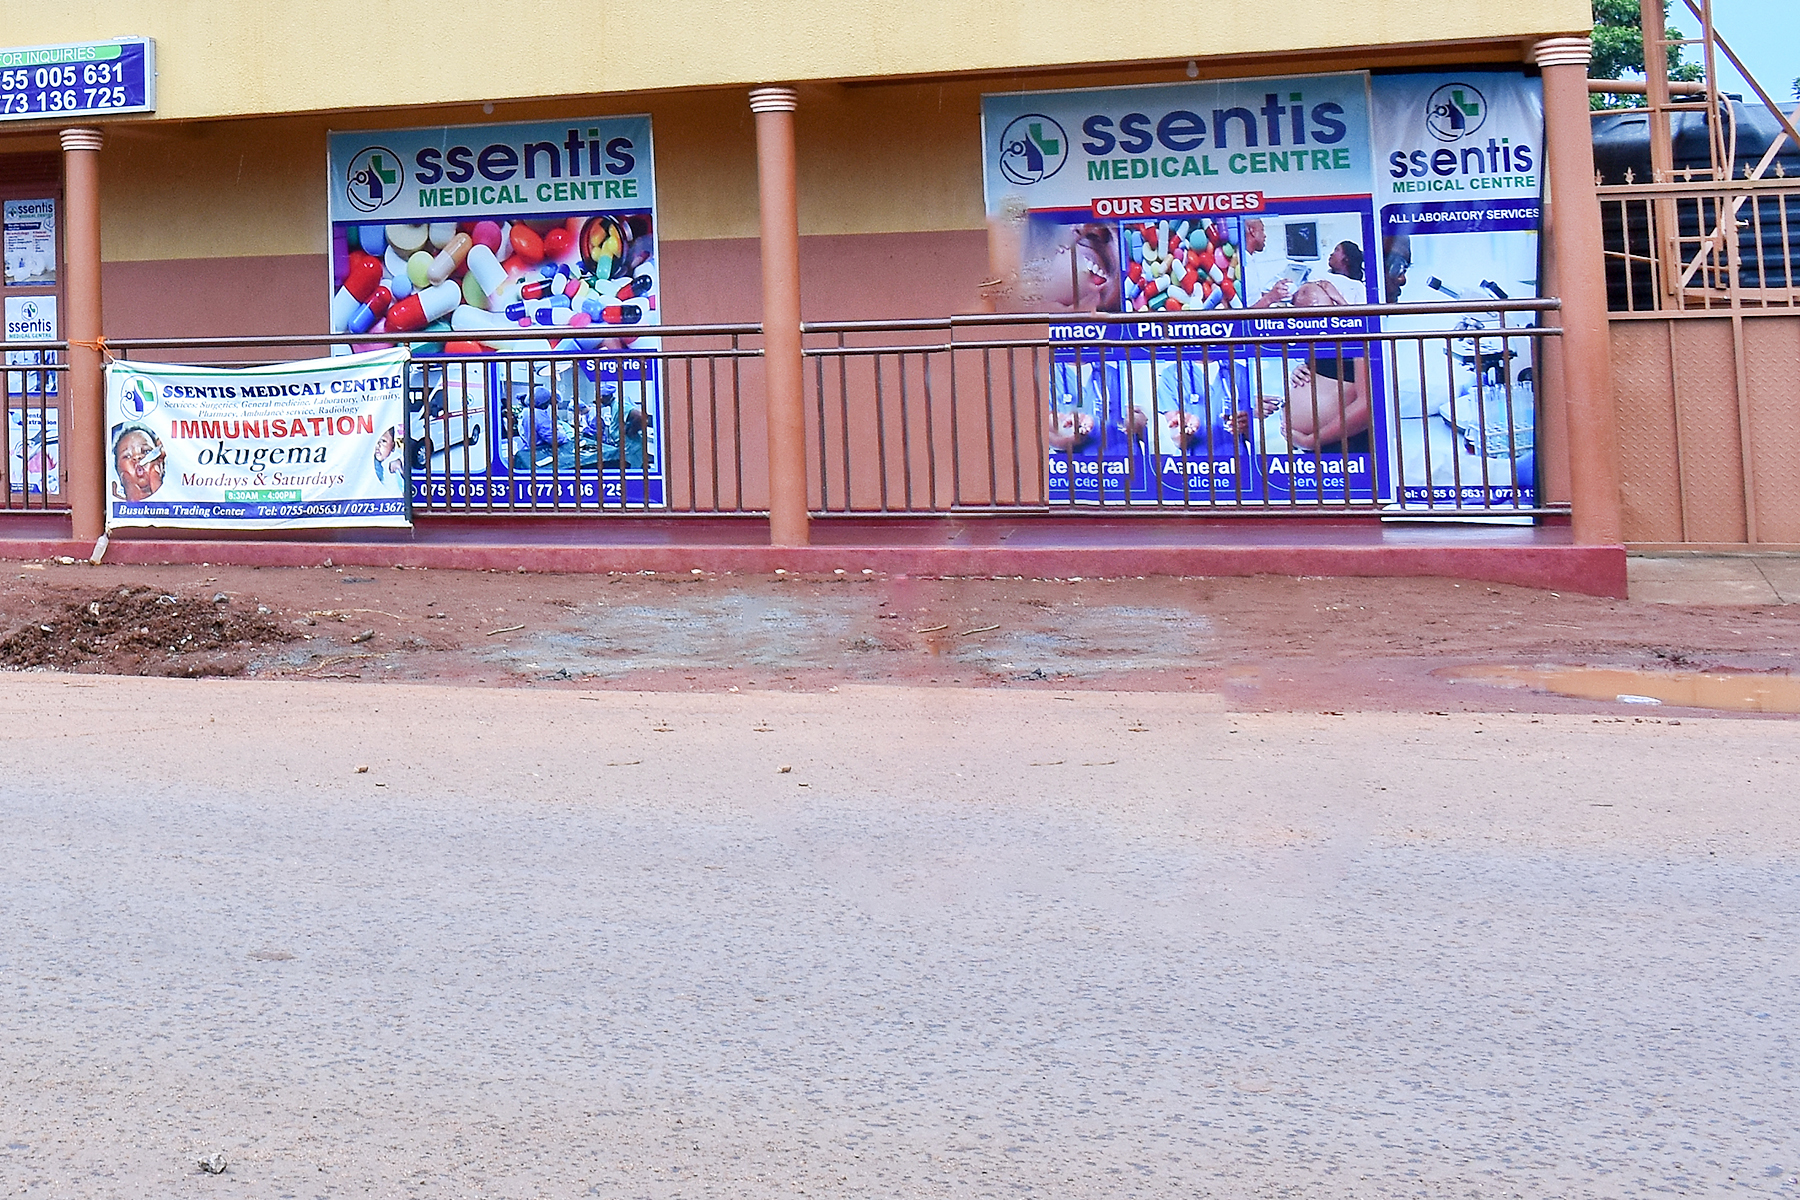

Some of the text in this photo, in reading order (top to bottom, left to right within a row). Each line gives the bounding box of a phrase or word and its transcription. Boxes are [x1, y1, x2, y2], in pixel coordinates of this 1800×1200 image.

[27, 47, 96, 64] INQUIRIES
[35, 65, 76, 88] 005
[83, 62, 123, 85] 631
[36, 89, 77, 111] 136
[84, 87, 126, 108] 725
[1082, 92, 1347, 156] ssentis
[415, 128, 635, 184] ssentis
[1087, 148, 1351, 181] MEDICAL CENTRE
[1389, 137, 1533, 178] ssentis
[419, 179, 638, 208] MEDICAL CENTRE
[1392, 175, 1536, 193] MEDICAL CENTRE
[18, 203, 53, 214] ssentis
[1096, 193, 1260, 216] OUR SERVICES
[1389, 207, 1540, 224] ALL LABORATORY SERVICES
[9, 318, 52, 333] ssentis
[1137, 322, 1234, 339] Pharmacy
[1254, 316, 1363, 330] Ultra Sound Scan
[162, 375, 402, 399] SSENTIS MEDICAL CENTRE
[241, 400, 272, 408] General
[318, 406, 359, 415] Radiology
[171, 414, 374, 439] IMMUNISATION
[197, 440, 327, 473] okugema
[180, 471, 345, 490] Mondays & Saturdays
[228, 490, 259, 501] 8:30AM
[267, 491, 296, 500] 4:00PM
[118, 505, 170, 516] Busukuma
[172, 505, 210, 517] Trading
[212, 505, 246, 516] Center
[257, 505, 278, 516] Tel:
[280, 503, 341, 516] 0755-005631
